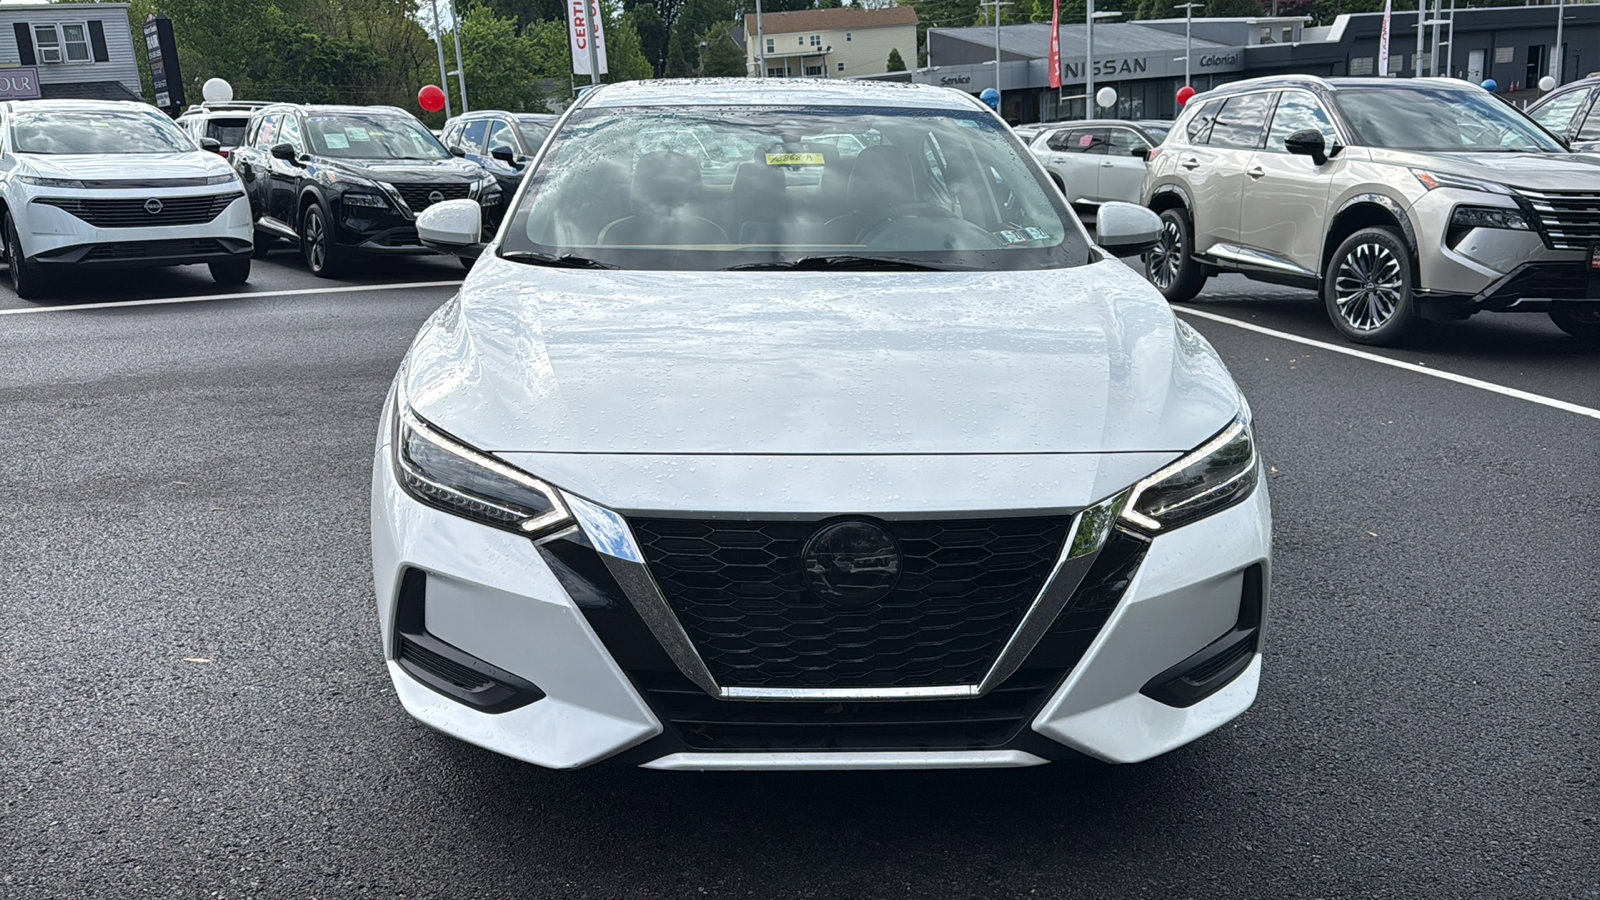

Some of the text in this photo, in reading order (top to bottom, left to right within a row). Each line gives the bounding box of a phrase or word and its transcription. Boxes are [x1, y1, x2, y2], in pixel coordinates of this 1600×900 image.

[573, 2, 586, 49] CERTI
[1200, 53, 1239, 67] Colonial
[1064, 58, 1147, 78] NISSAN
[0, 76, 31, 91] OUR
[940, 74, 971, 86] Service
